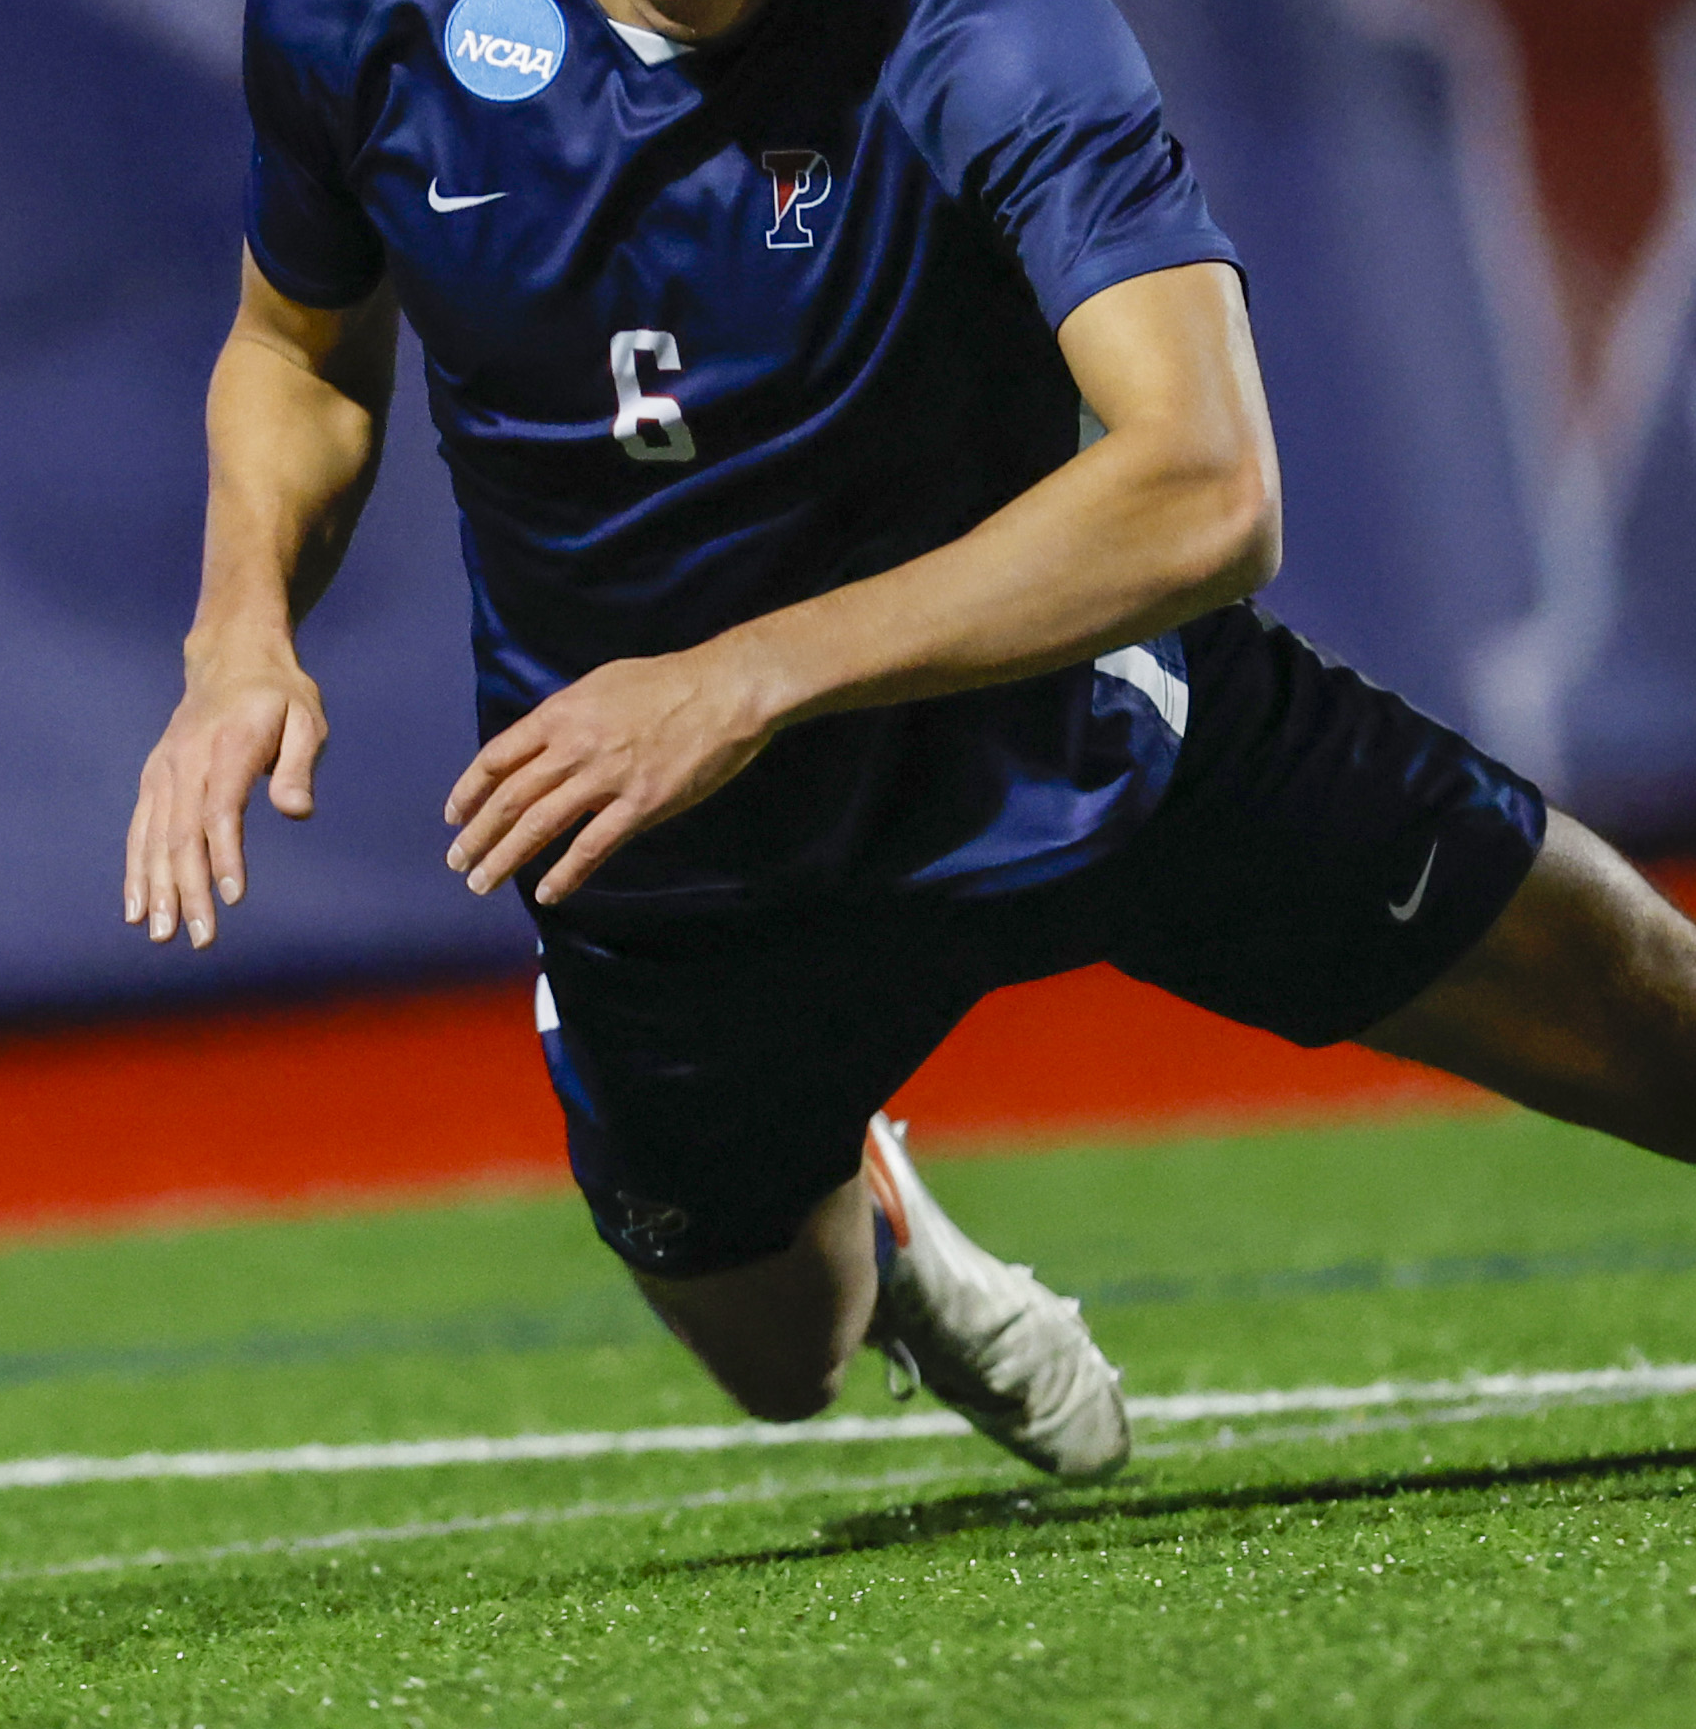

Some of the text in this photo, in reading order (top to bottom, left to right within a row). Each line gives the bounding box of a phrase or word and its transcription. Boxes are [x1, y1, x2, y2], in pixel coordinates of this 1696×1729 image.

[456, 29, 554, 80] NCAA
[762, 150, 832, 249] P
[609, 328, 697, 463] 6
